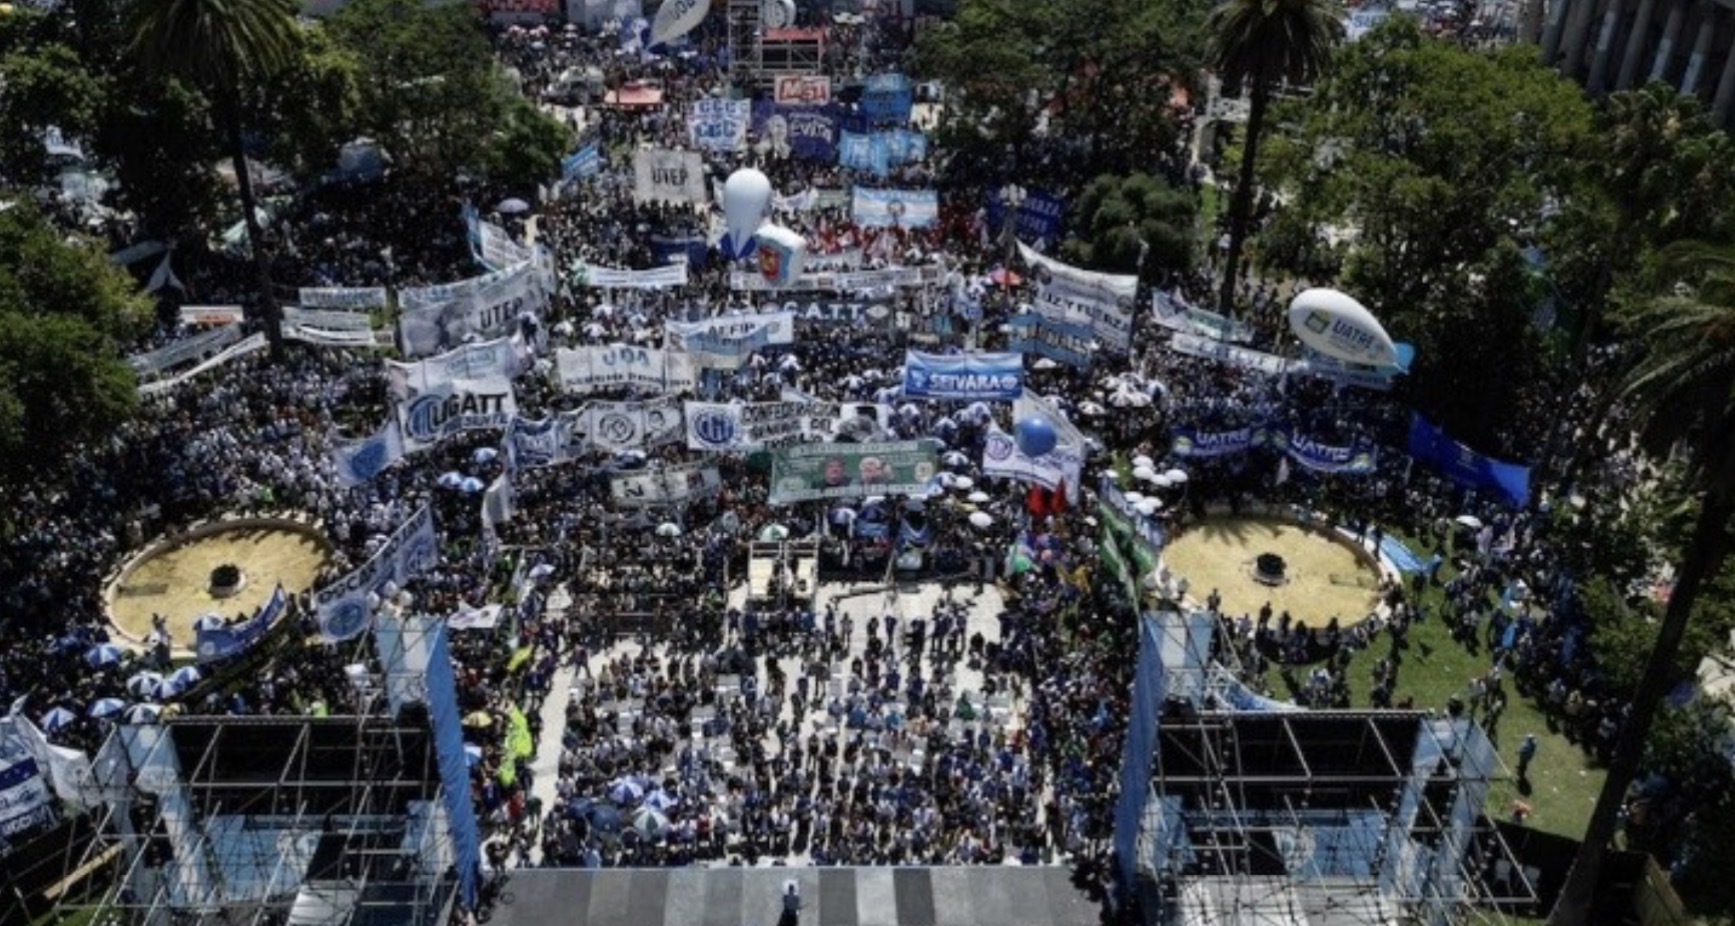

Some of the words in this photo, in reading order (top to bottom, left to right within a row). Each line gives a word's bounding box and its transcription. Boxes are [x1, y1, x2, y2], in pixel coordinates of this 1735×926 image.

[652, 168, 688, 186] UTEP
[480, 297, 523, 330] UTEP
[1332, 320, 1376, 350] UATRE
[602, 346, 651, 366] UDA
[430, 392, 508, 428] UGATT
[1196, 428, 1248, 445] UATRE
[1291, 427, 1350, 461] UATRE
